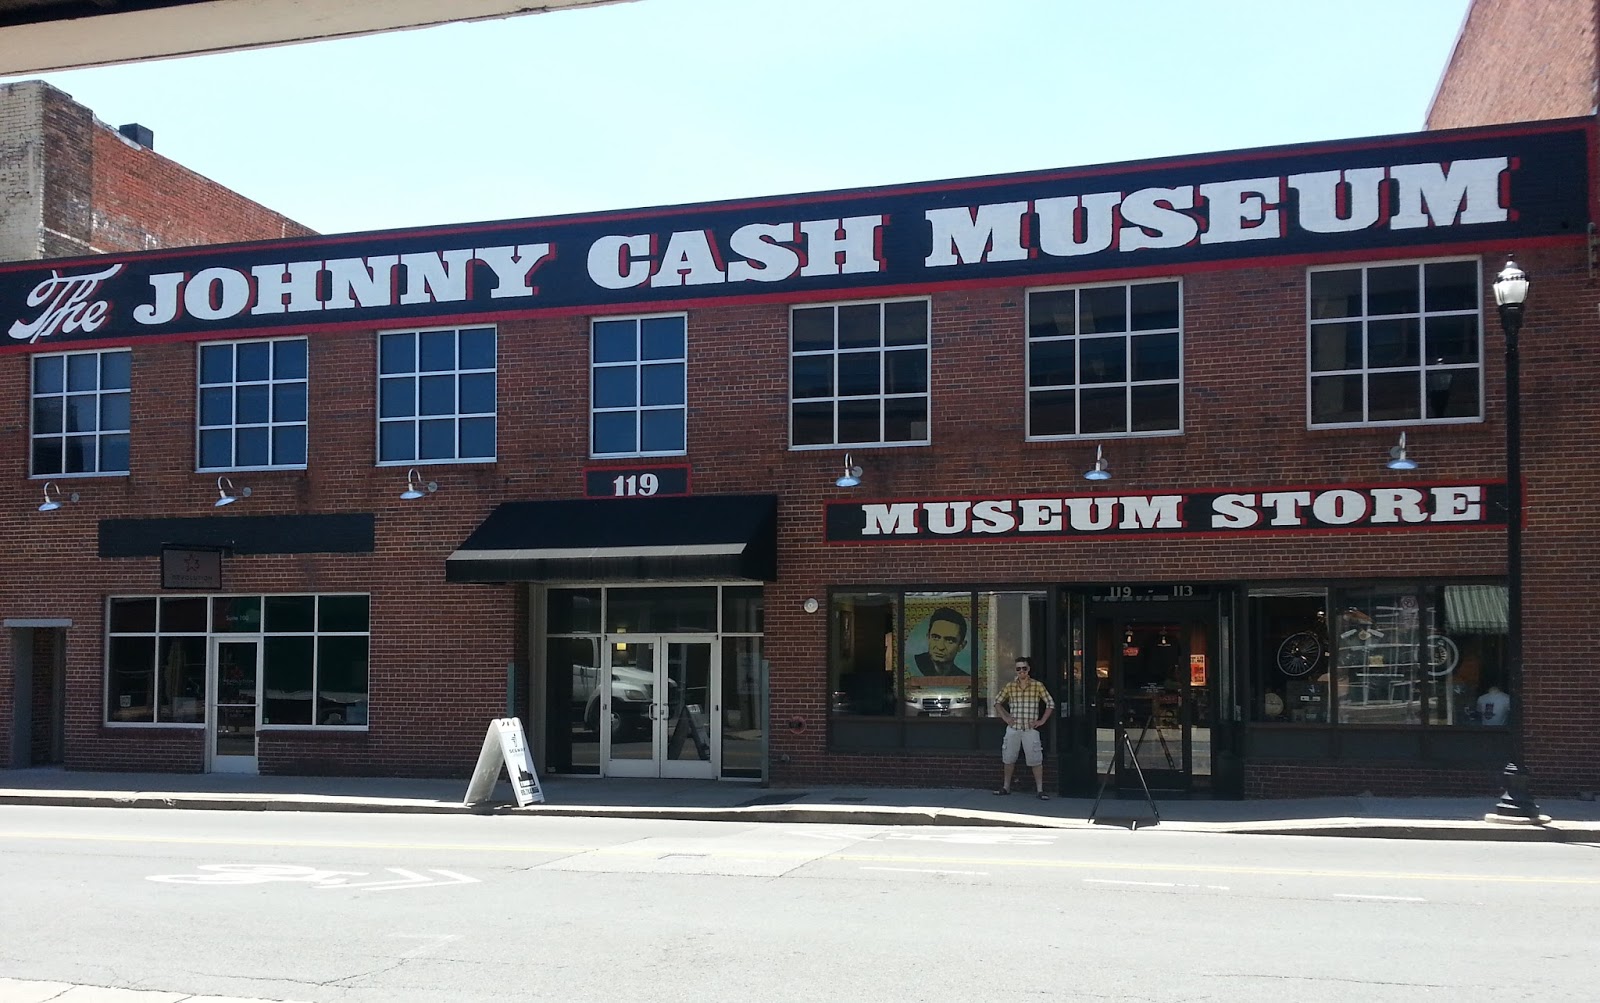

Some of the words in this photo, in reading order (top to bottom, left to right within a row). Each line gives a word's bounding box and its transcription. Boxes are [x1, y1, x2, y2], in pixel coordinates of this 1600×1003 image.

[8, 263, 123, 344] The
[132, 242, 550, 325] JOHNNY
[586, 214, 883, 290] CASH
[923, 156, 1509, 268] MUSEUM
[613, 473, 659, 496] 119
[861, 495, 1183, 535] MUSEUM
[1211, 486, 1482, 529] STORE
[1110, 586, 1132, 598] 119
[1173, 585, 1194, 597] 113
